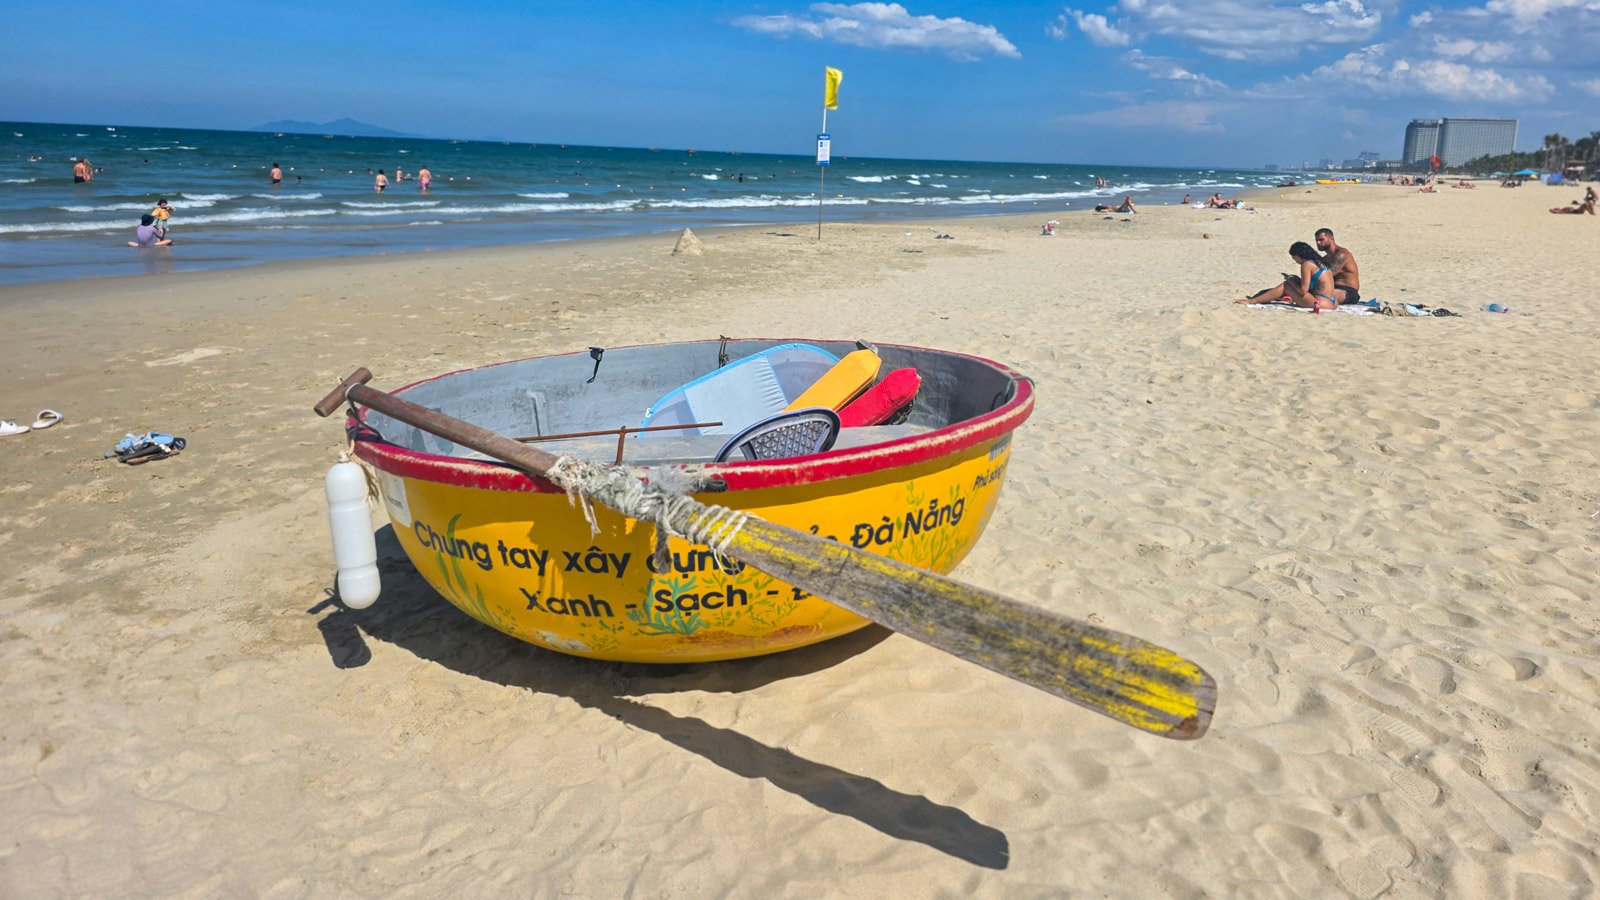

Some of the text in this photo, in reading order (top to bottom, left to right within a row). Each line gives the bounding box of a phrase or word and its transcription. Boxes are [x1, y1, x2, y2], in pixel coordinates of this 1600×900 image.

[414, 520, 493, 571] Chung
[497, 540, 549, 577] tay
[562, 546, 631, 578] xây
[850, 516, 894, 549] Đà
[903, 498, 965, 539] Nẵng
[519, 587, 615, 617] Xanh
